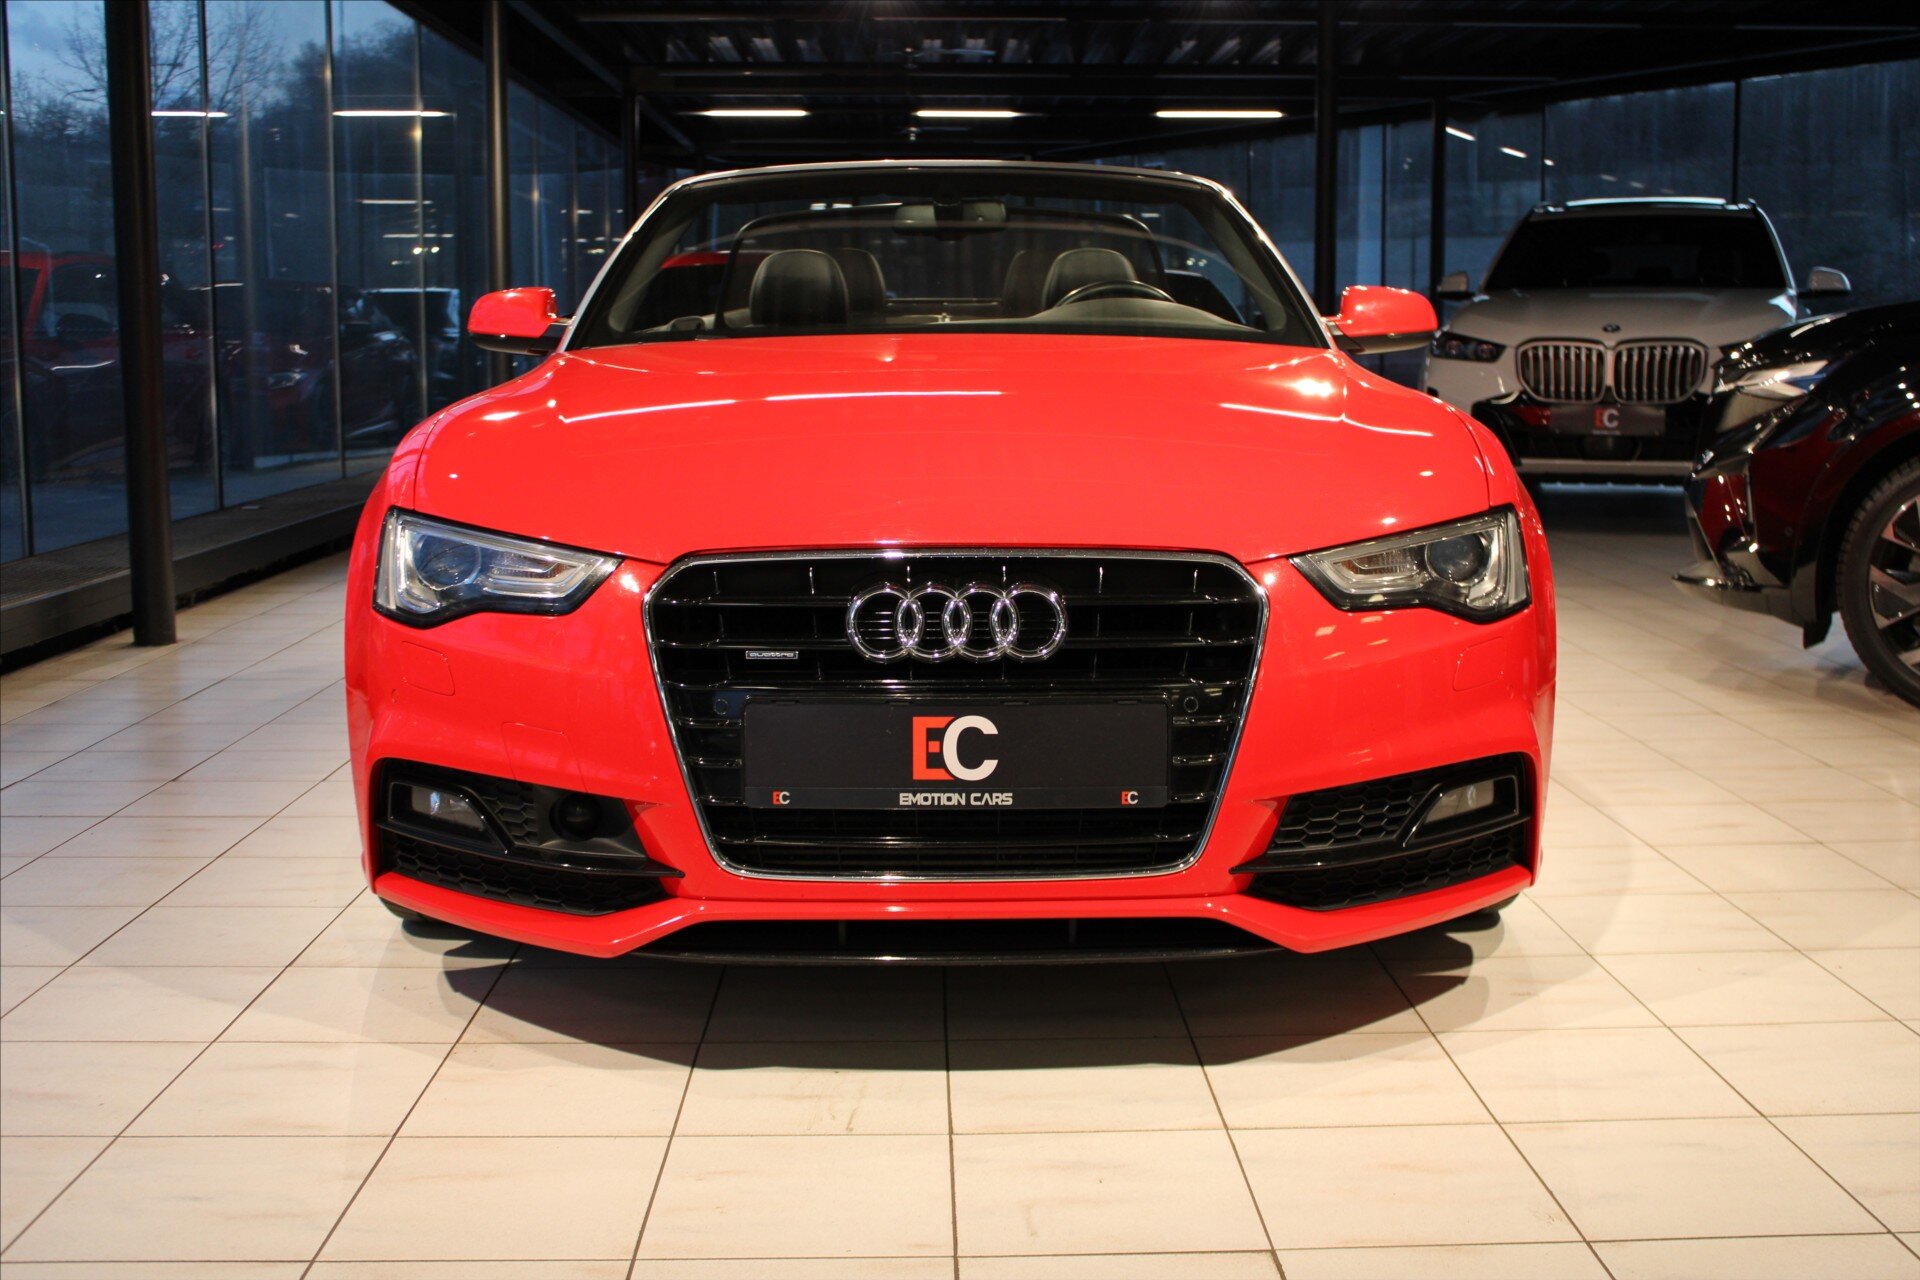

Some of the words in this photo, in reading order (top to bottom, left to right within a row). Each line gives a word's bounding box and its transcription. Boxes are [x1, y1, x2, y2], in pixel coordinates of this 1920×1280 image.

[912, 715, 999, 781] EC
[773, 791, 790, 804] EC
[899, 793, 966, 806] EMOTION
[970, 793, 1013, 806] CARS
[1121, 791, 1139, 804] EC
